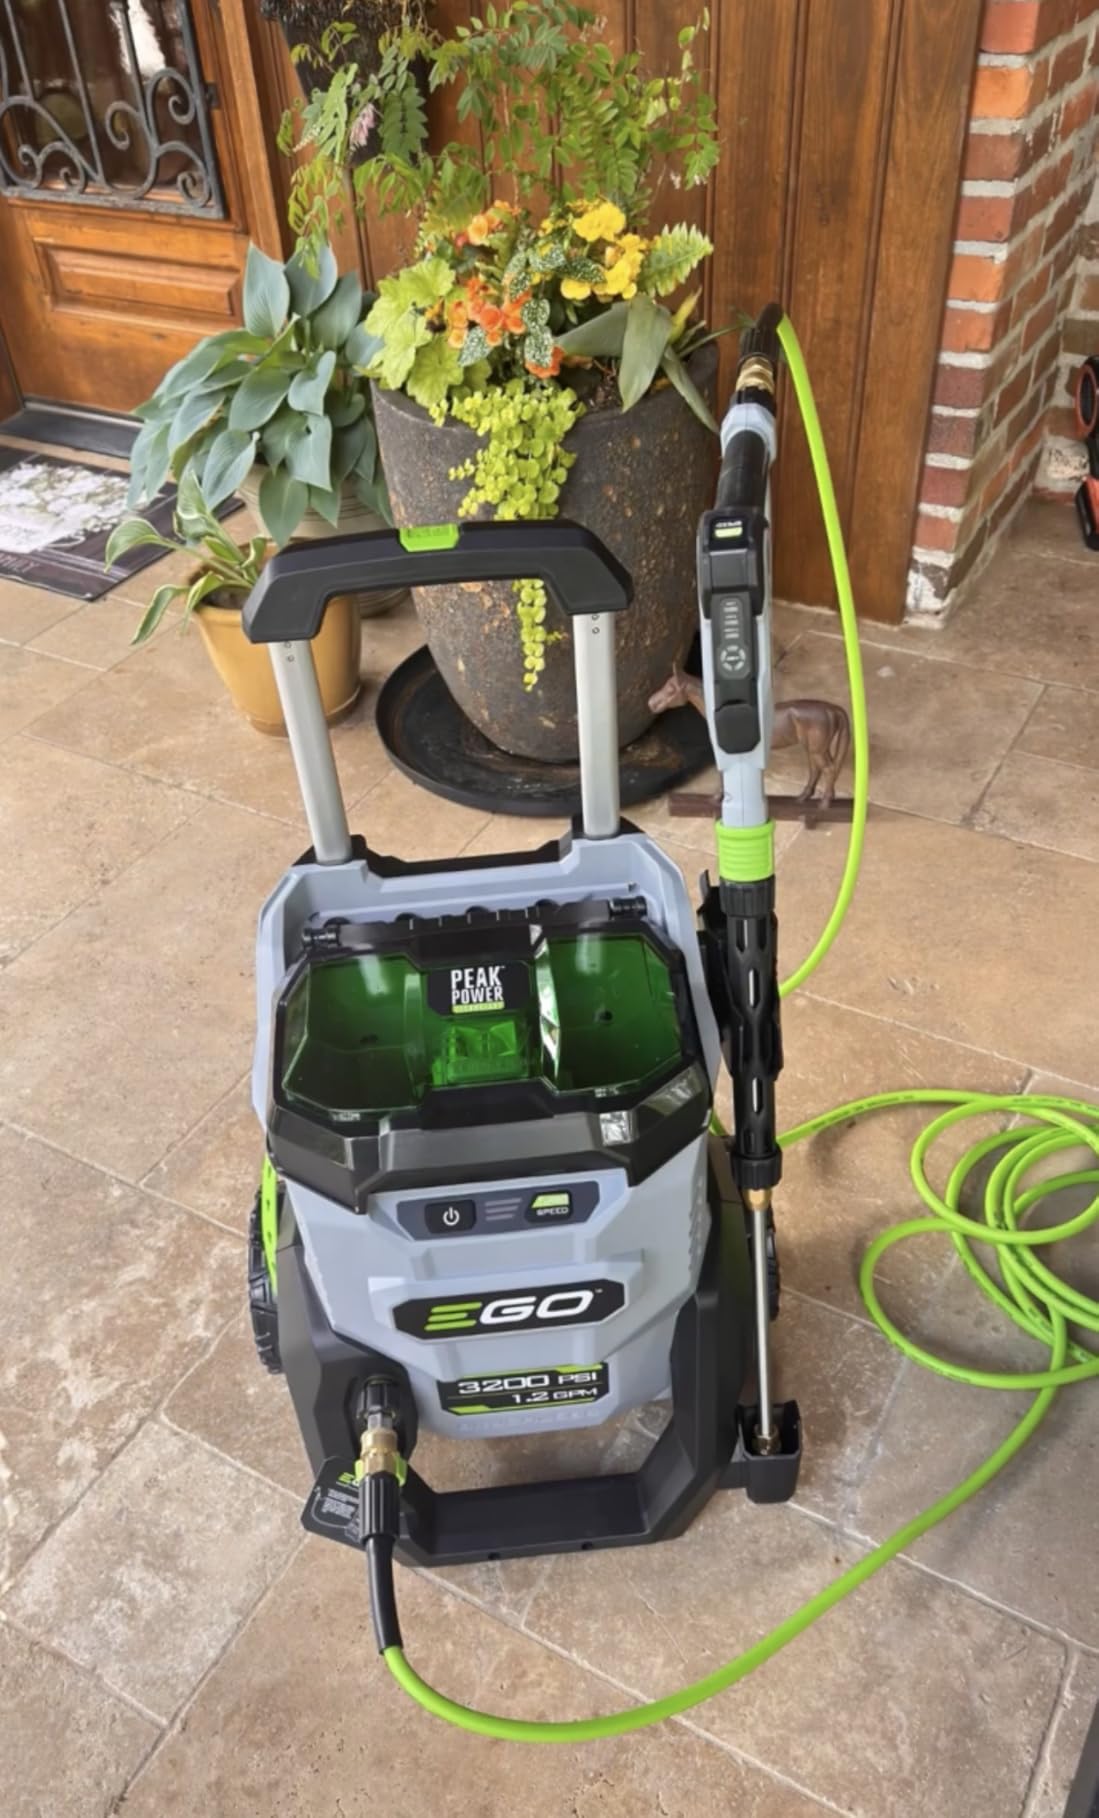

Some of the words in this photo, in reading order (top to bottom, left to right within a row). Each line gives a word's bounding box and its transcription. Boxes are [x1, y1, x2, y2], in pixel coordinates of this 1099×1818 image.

[450, 965, 502, 990] PEAK
[451, 986, 504, 1005] POWER
[424, 1290, 594, 1332] EGO
[458, 1374, 550, 1395] 3200
[558, 1371, 597, 1385] PSI
[511, 1391, 549, 1404] 1.2
[552, 1387, 598, 1400] GPM
